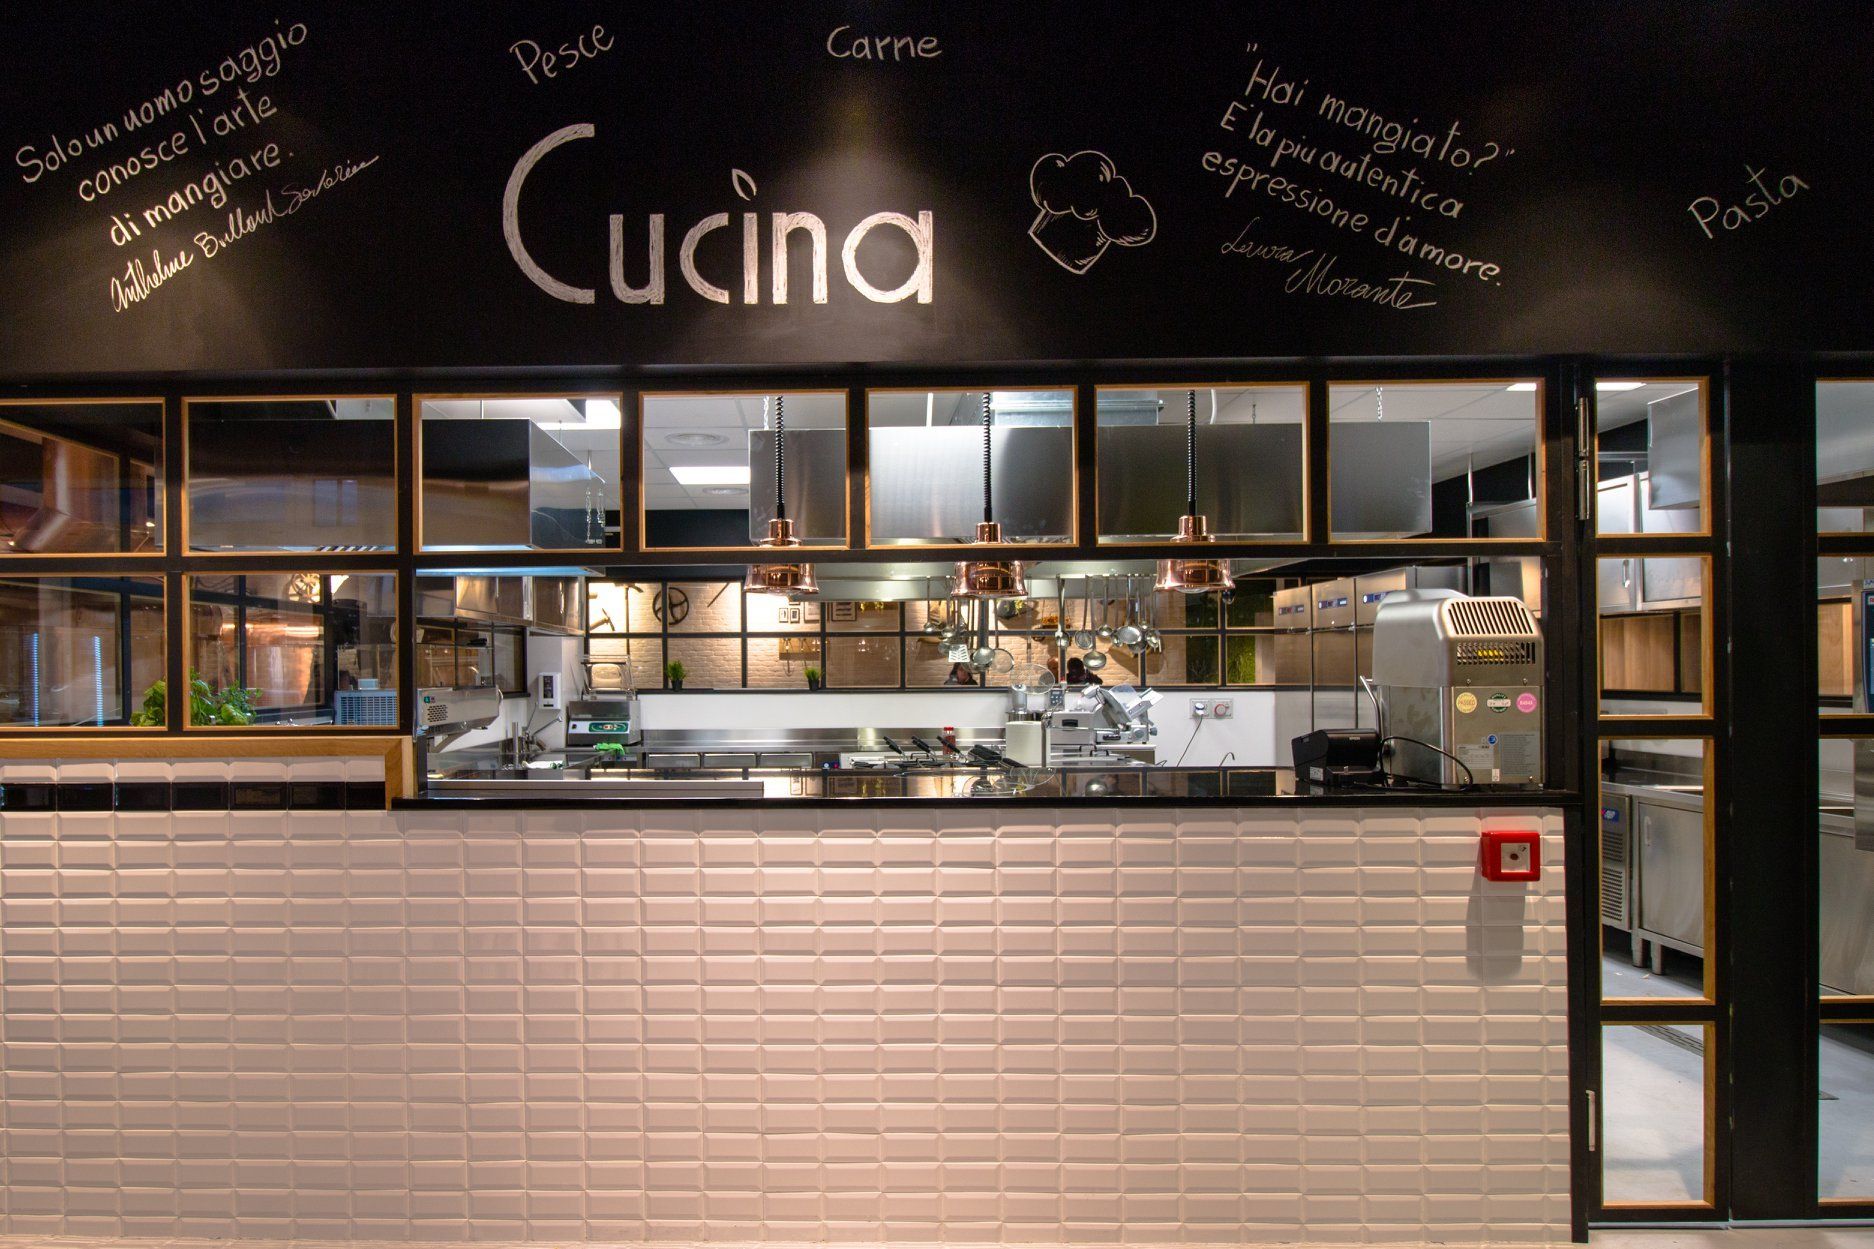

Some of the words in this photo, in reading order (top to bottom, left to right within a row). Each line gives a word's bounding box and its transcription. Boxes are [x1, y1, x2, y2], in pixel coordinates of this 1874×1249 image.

[124, 79, 193, 132] uomo
[199, 18, 308, 95] saggio
[509, 24, 615, 85] Pesce
[826, 25, 943, 62] Carne
[79, 131, 189, 202] conosce
[190, 87, 277, 145] l'arte
[1249, 111, 1277, 147] la
[1319, 153, 1464, 219] autentica
[110, 213, 141, 247] di
[143, 143, 294, 229] mangiare.
[502, 123, 933, 305] Cucina
[1201, 151, 1369, 232] espressione
[1687, 164, 1810, 239] Pasta
[1285, 253, 1437, 310] Morante
